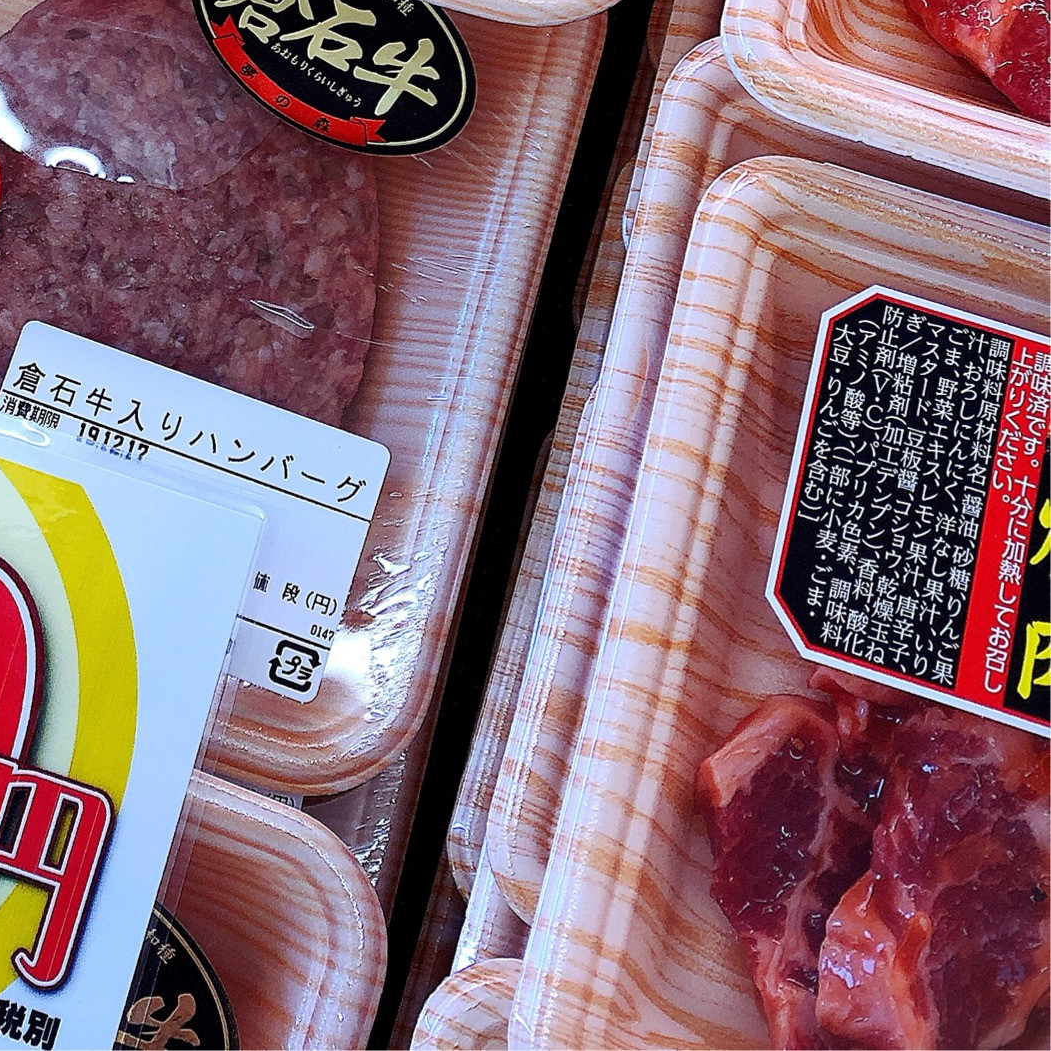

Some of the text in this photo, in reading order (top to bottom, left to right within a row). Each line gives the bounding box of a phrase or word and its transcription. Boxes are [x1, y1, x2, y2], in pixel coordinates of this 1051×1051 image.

[270, 41, 362, 108] あおもりくらいしぎゅう
[0, 395, 61, 430] 消費期限
[12, 361, 367, 504] 倉石牛入りハンバーグ
[992, 346, 1034, 504] 上がりください。
[309, 624, 335, 642] 0147
